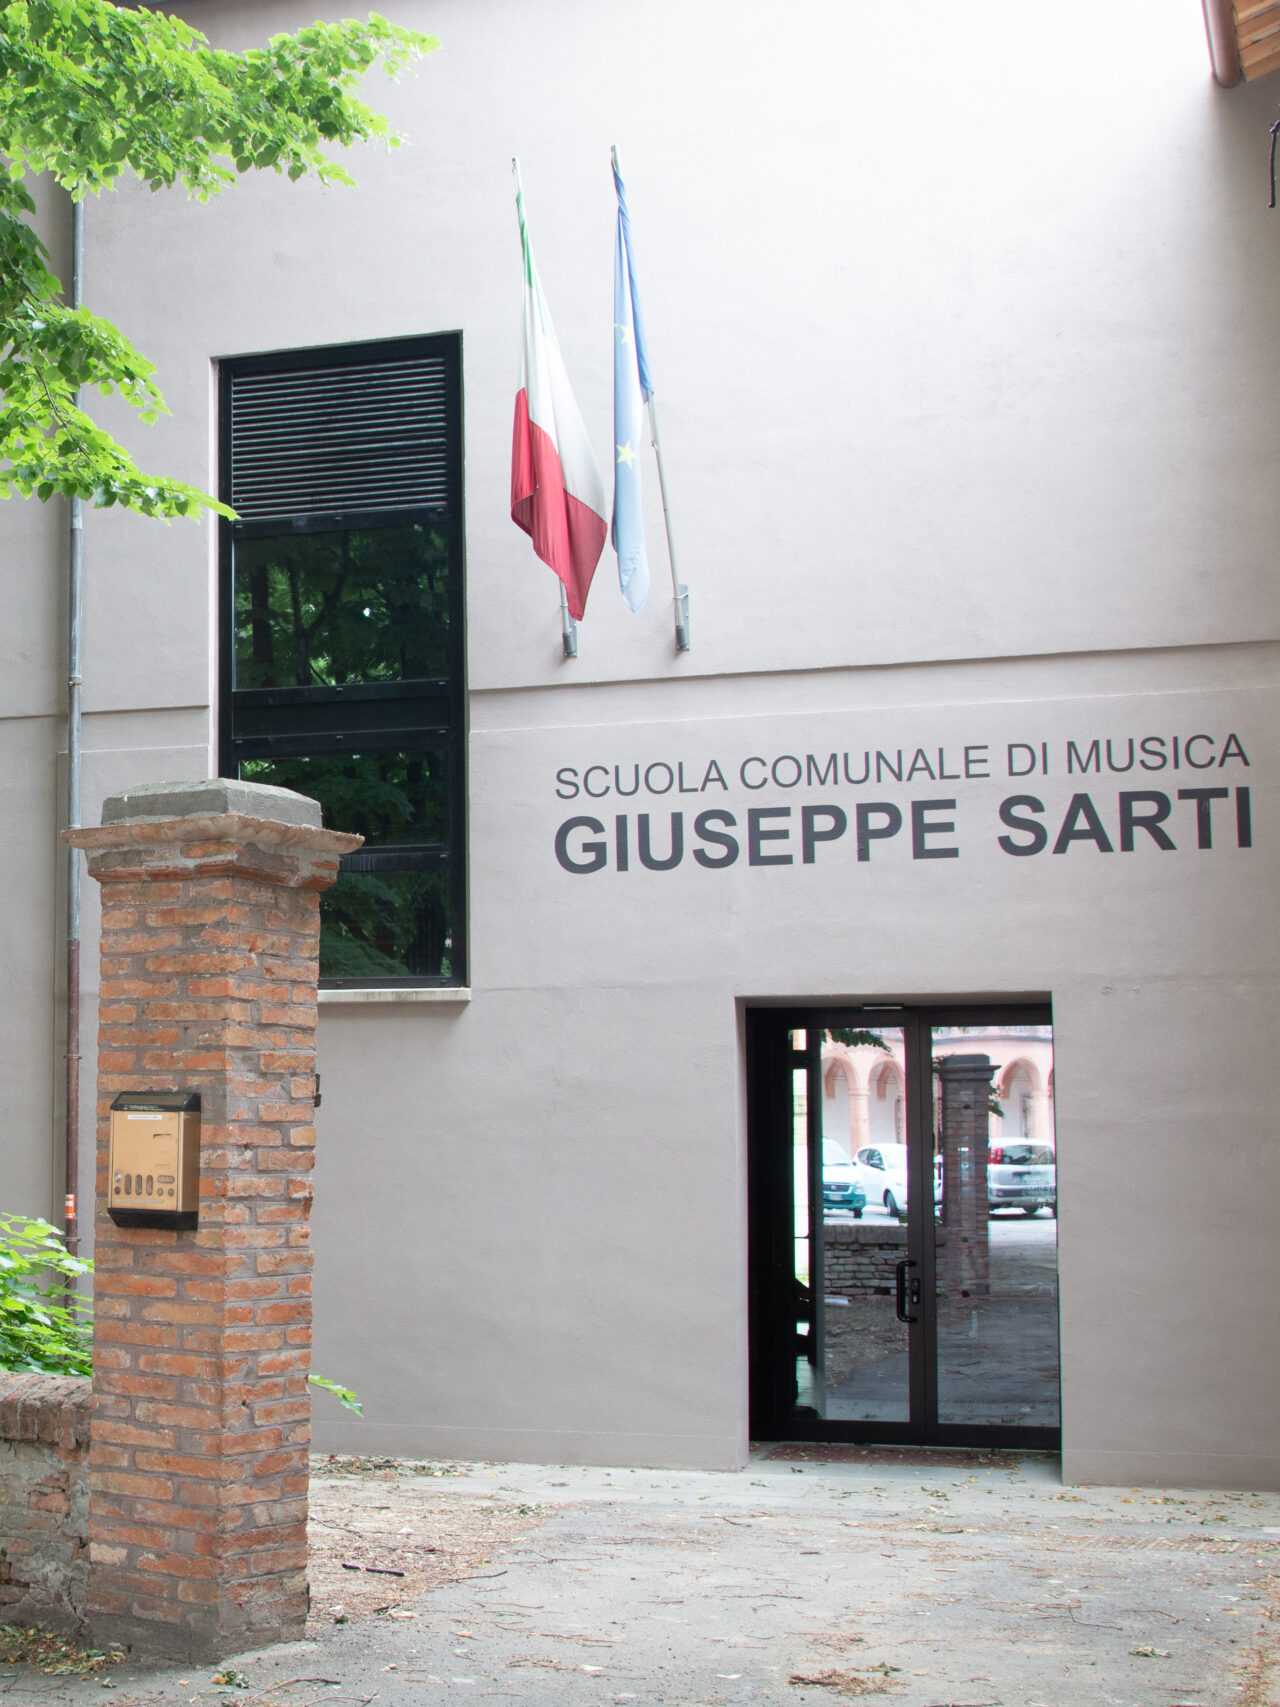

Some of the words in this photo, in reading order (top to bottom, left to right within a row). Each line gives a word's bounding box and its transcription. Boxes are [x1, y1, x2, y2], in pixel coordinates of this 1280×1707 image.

[556, 759, 729, 800] SCUOLA
[739, 745, 991, 790] COMUNALE
[1007, 742, 1049, 777] DI
[1066, 733, 1251, 775] MUSICA
[554, 798, 960, 875] GIUSEPPE
[997, 786, 1253, 857] SARTI
